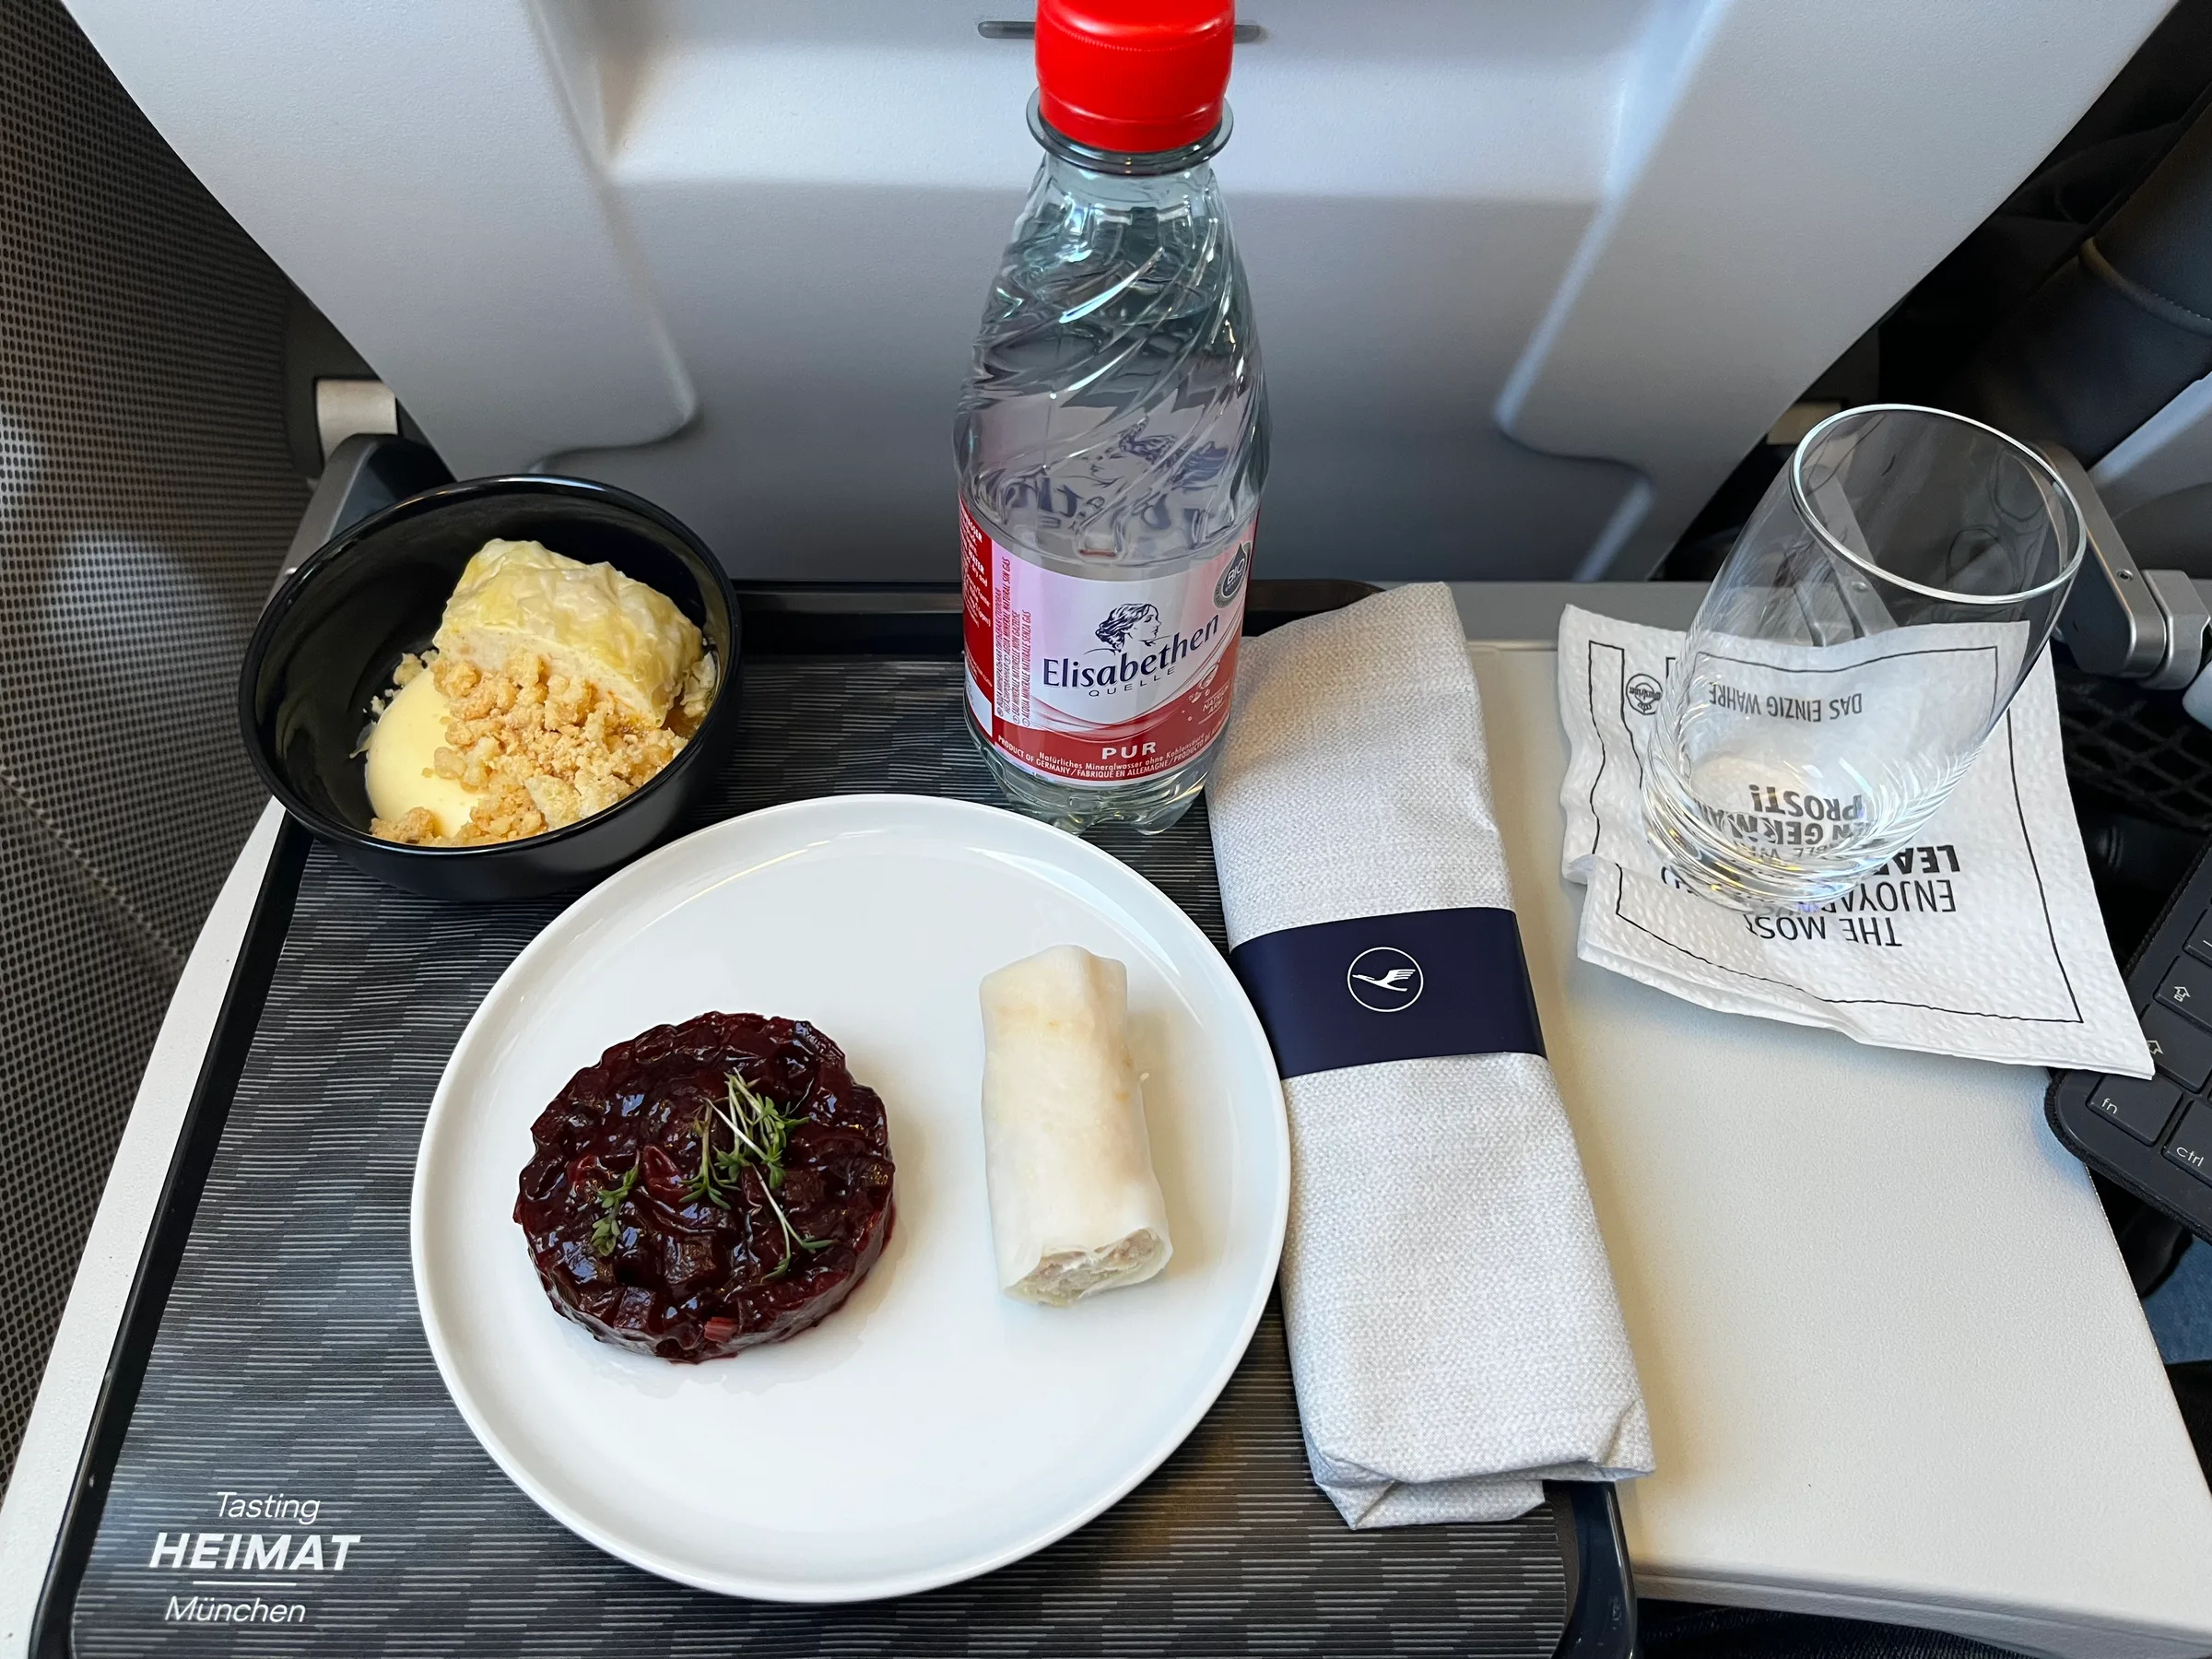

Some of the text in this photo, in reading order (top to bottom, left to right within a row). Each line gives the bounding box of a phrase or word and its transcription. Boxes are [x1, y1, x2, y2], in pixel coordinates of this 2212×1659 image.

[1227, 558, 1245, 584] BIO
[1043, 614, 1218, 688] Elisabethen
[1088, 666, 1175, 698] QUELLE
[1709, 682, 1863, 721] DAS EINZIG WAHRE
[998, 735, 1024, 758] PRODUCT
[1026, 753, 1034, 762] OF
[1039, 752, 1083, 770] Natürliches
[1085, 761, 1142, 771] Mineralwasser
[1145, 756, 1163, 765] ohne
[1101, 741, 1157, 760] PUR
[1748, 783, 1863, 821] PROST!
[1743, 915, 1902, 947] THE MOST
[2101, 1097, 2118, 1114] fn
[2175, 1145, 2205, 1168] ctrl
[217, 1491, 321, 1524] Tasting
[149, 1532, 361, 1571] HEIMAT
[164, 1595, 306, 1623] München
